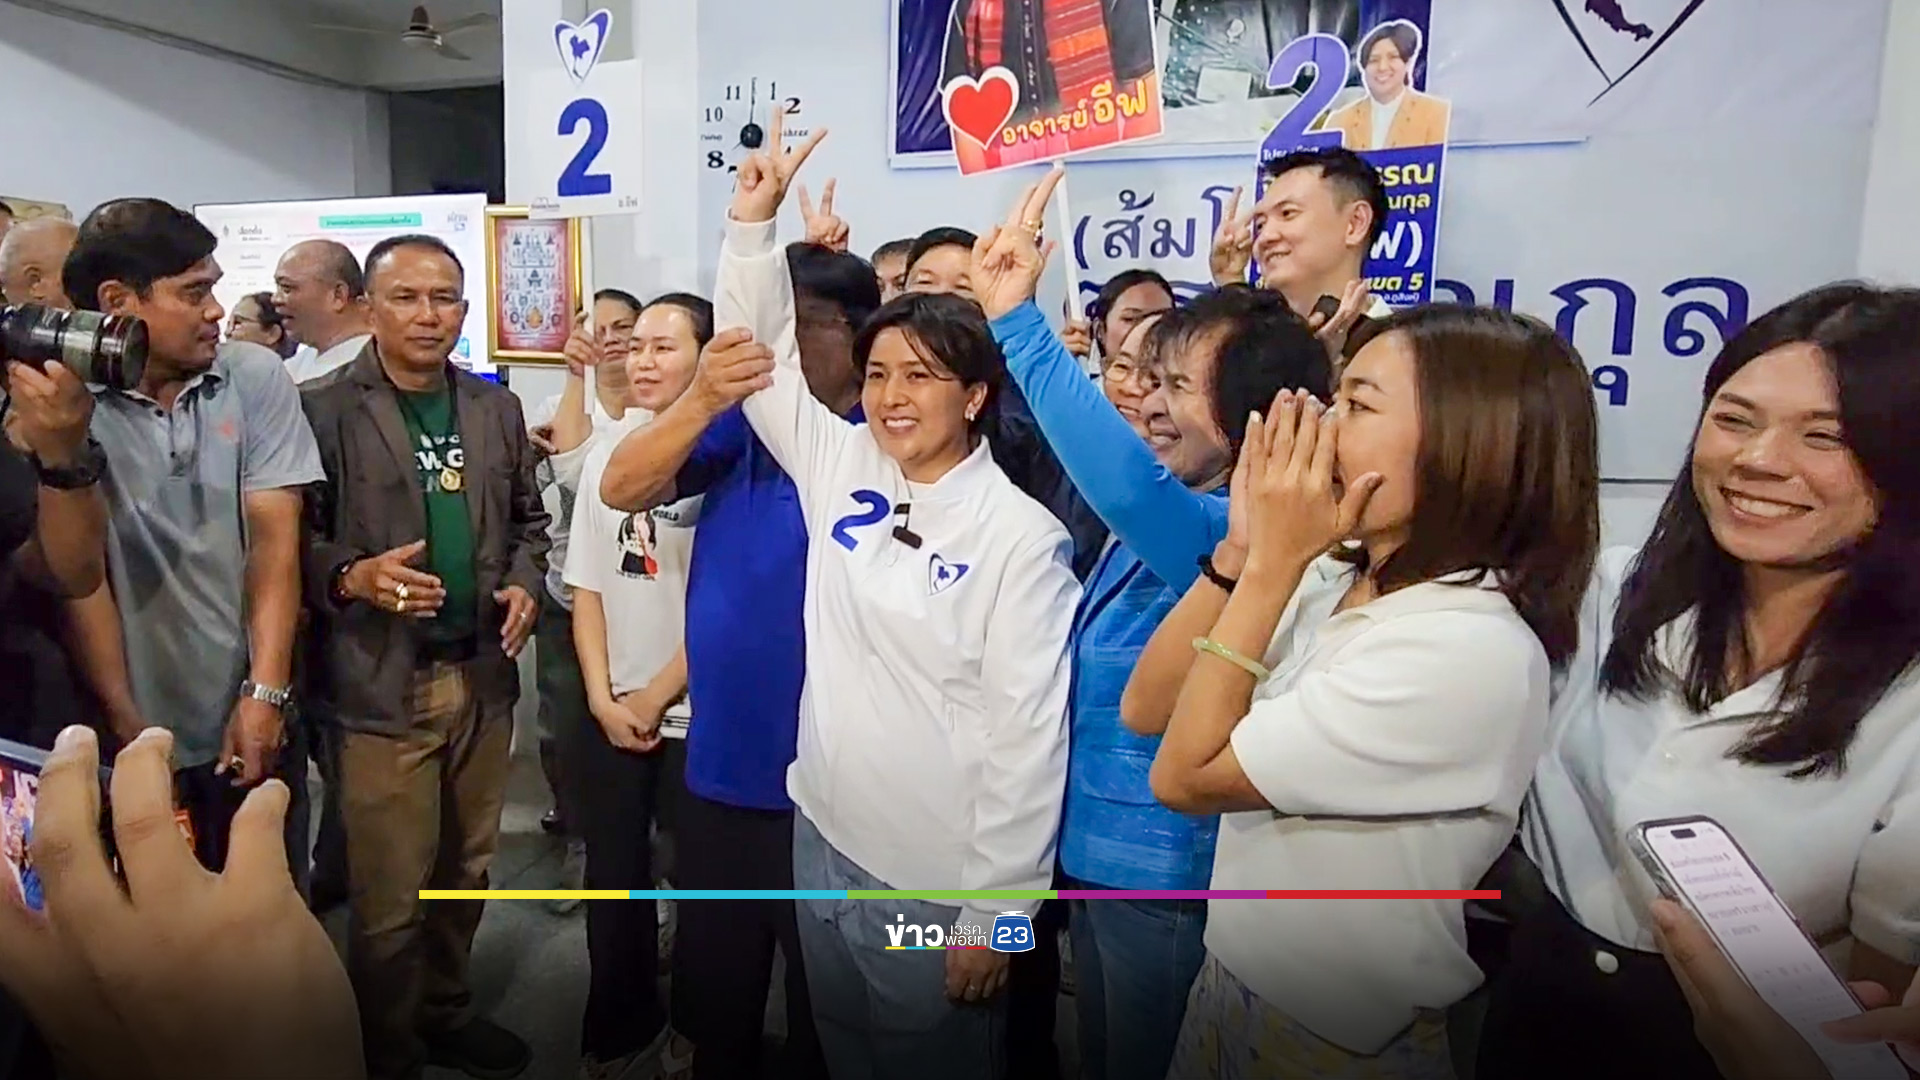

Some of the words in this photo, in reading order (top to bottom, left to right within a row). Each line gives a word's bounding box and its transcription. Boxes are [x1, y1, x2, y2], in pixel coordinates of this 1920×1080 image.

[725, 85, 741, 101] 11
[770, 81, 776, 101] 1
[1262, 32, 1350, 147] 2
[705, 106, 724, 122] 10
[784, 97, 801, 115] 2
[1002, 98, 1088, 145] อาจารย์
[1090, 79, 1148, 124] อีฟ
[557, 97, 612, 197] 2
[707, 150, 725, 169] 8
[1407, 272, 1424, 291] 5
[831, 489, 891, 552] 2
